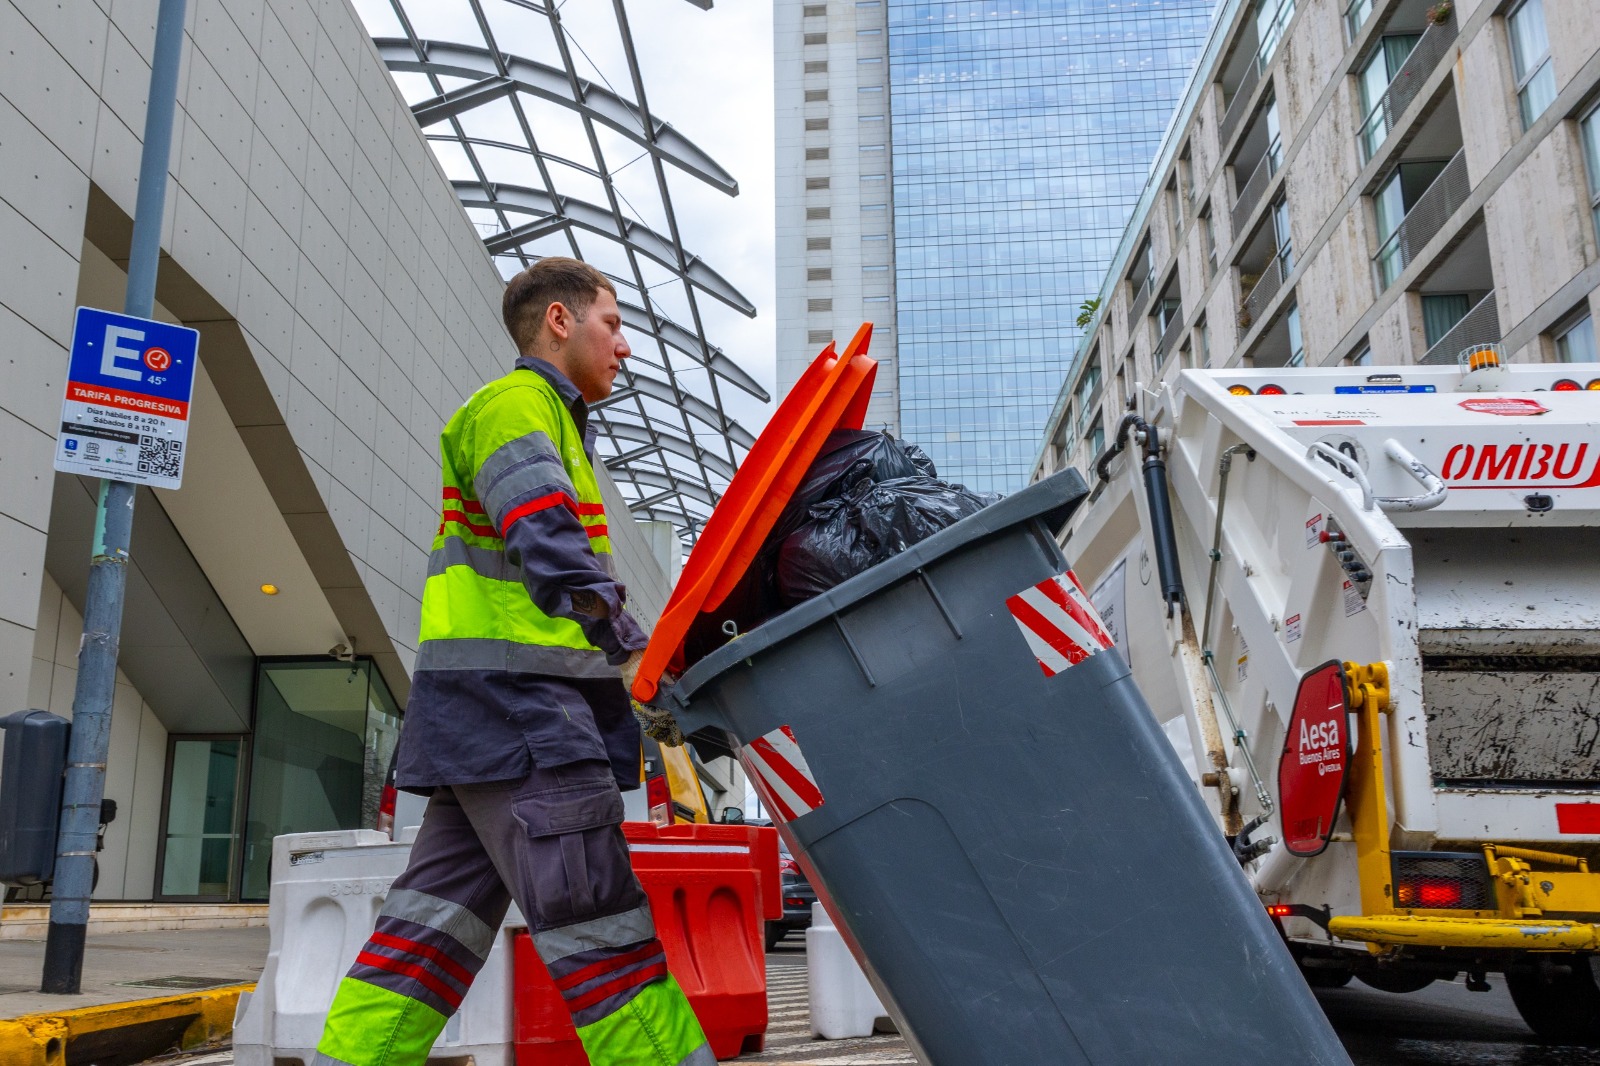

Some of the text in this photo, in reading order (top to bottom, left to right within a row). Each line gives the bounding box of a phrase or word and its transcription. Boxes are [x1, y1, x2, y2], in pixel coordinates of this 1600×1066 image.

[100, 324, 145, 381] E
[73, 388, 181, 415] TARIFA PROGRESIVA
[87, 406, 104, 415] Días
[105, 410, 131, 421] hábiles
[147, 417, 158, 425] 20
[93, 416, 125, 428] Sábados
[1441, 443, 1589, 480] OMBU
[1299, 718, 1339, 752] Aesa
[1299, 747, 1340, 765] Buenos Aires
